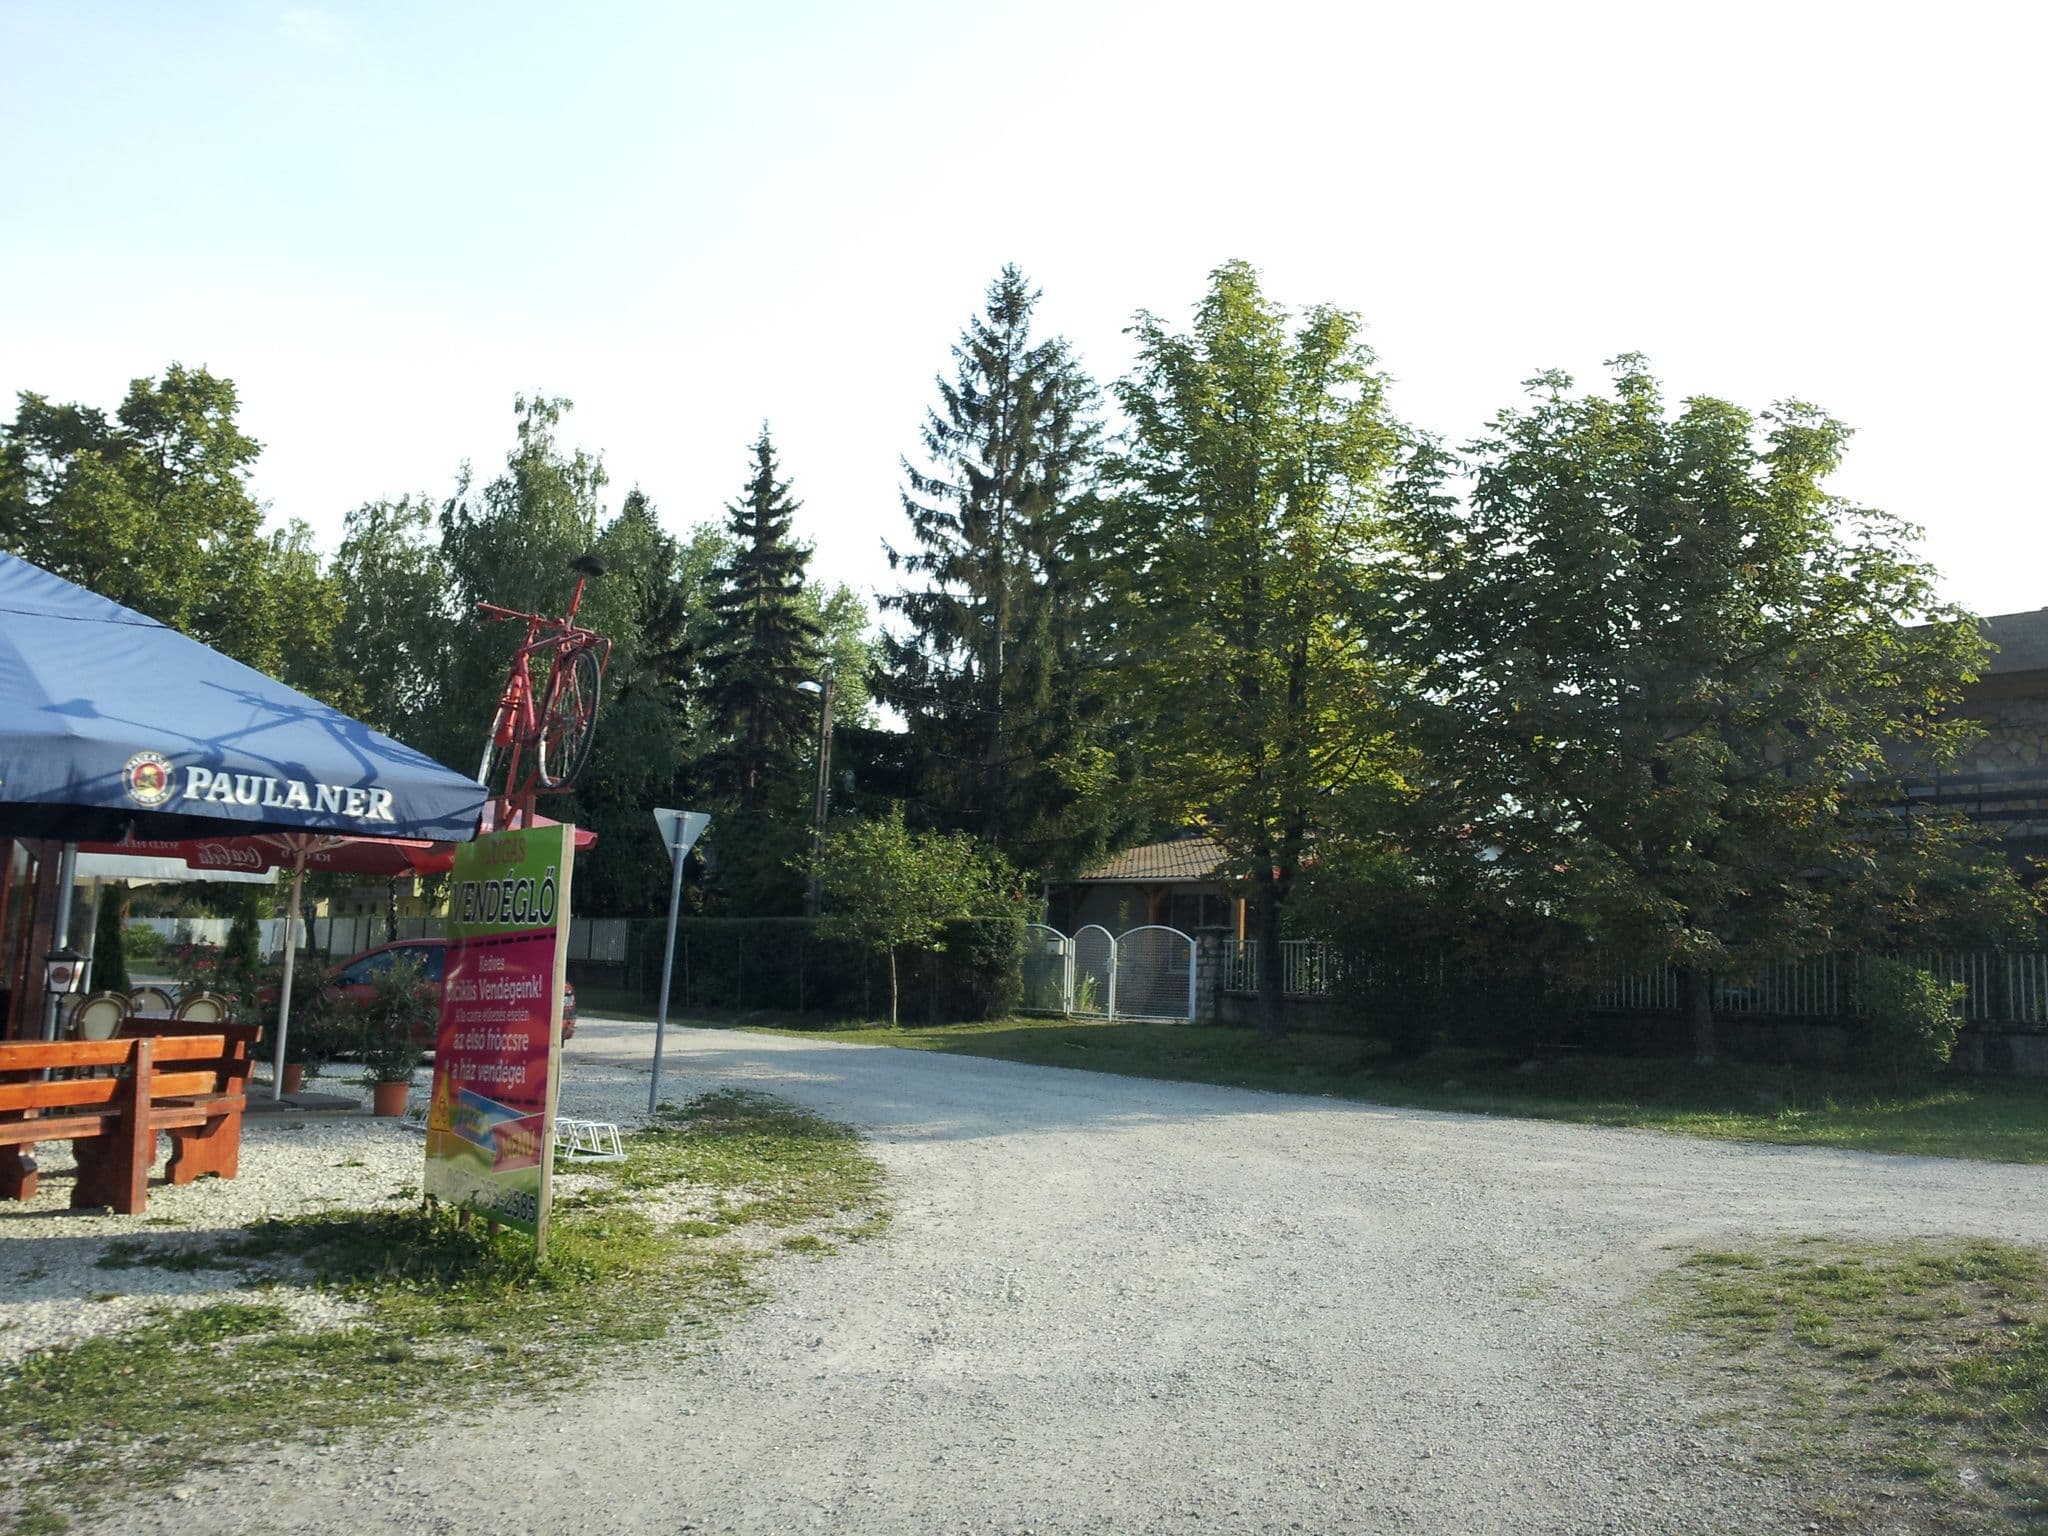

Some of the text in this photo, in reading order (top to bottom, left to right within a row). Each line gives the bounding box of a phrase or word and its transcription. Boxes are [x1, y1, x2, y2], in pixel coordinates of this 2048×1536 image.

[183, 766, 395, 821] PAULANER
[453, 865, 557, 925] VENDÉGLŐ
[479, 955, 505, 972] Kedves
[478, 974, 543, 1006] Vendégeink!
[453, 1033, 465, 1050] az
[487, 1028, 529, 1051] fröccsre
[452, 1063, 459, 1079] a
[478, 1060, 526, 1090] vendégei
